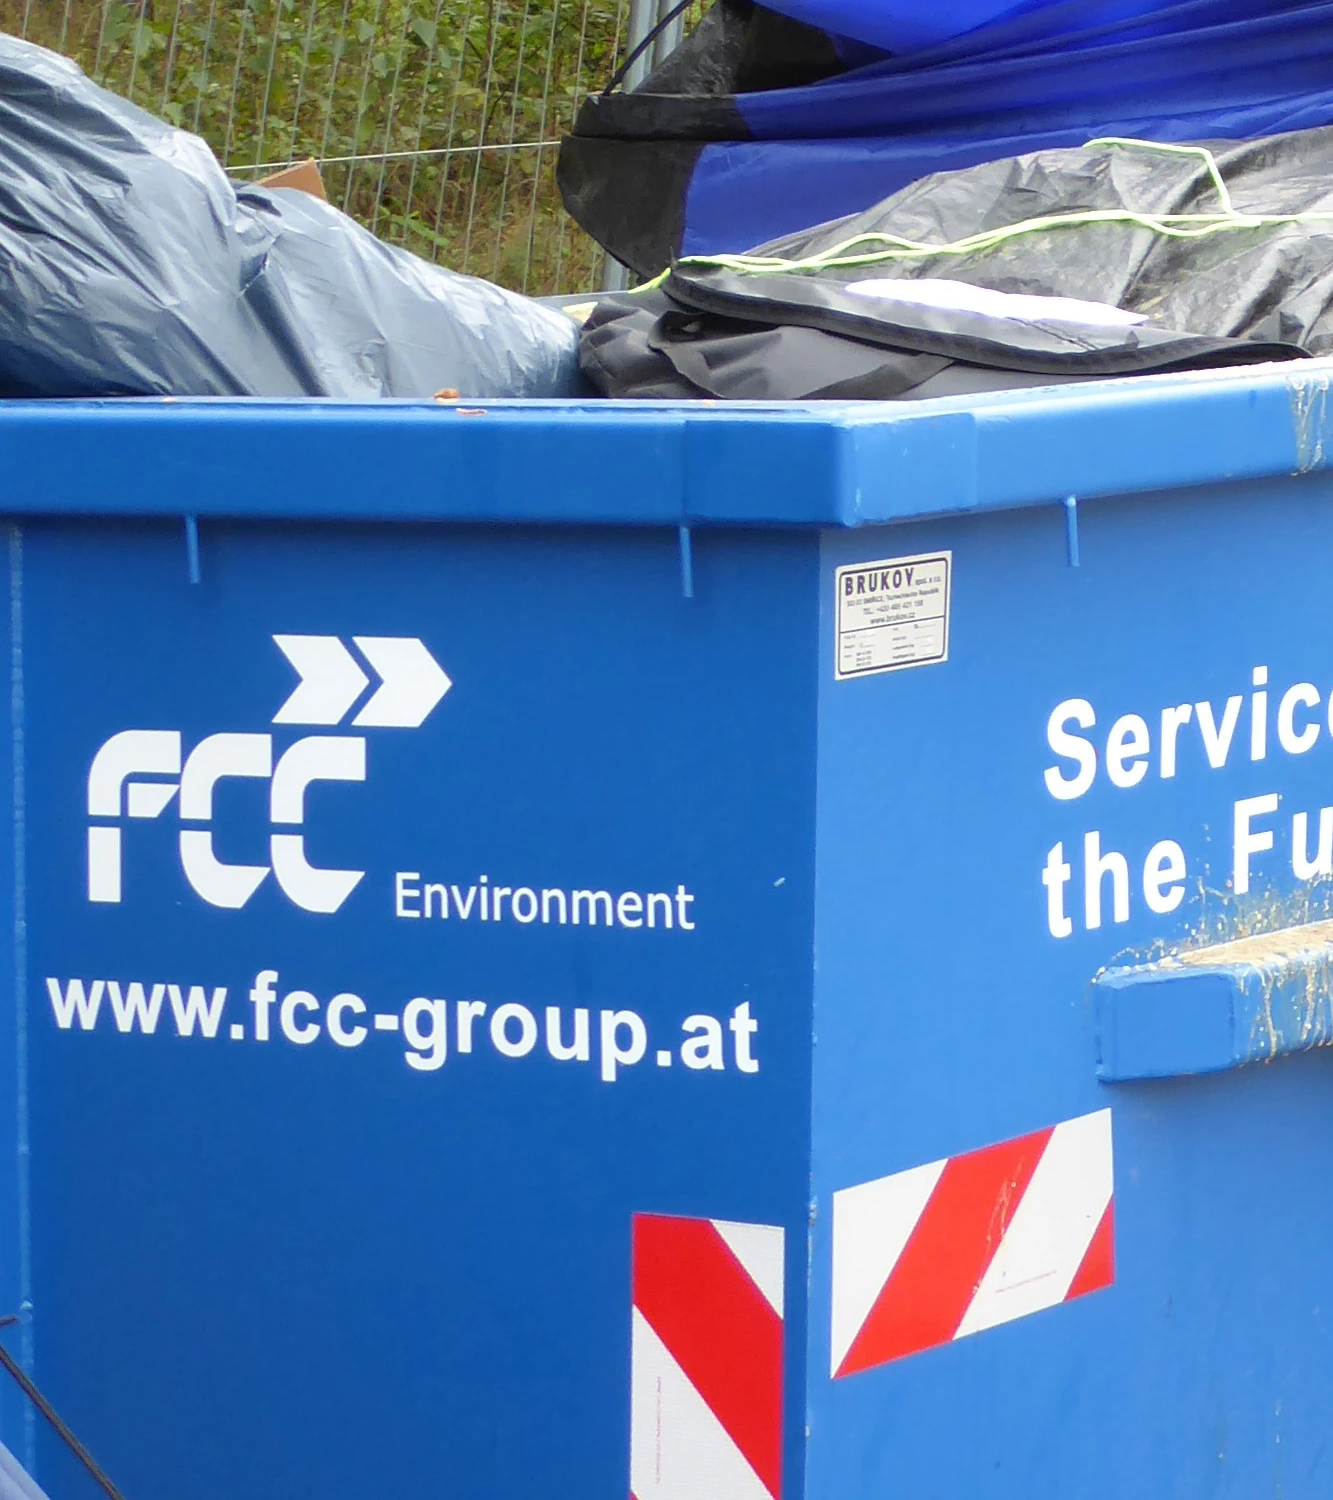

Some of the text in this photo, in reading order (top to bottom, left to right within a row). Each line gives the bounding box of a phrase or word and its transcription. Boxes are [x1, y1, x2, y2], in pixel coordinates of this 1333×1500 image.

[845, 567, 914, 596] BRUKOV
[88, 729, 367, 913] FCC
[396, 872, 695, 931] Environment
[1042, 830, 1187, 939] the
[46, 970, 760, 1083] www.fcc-group.at
